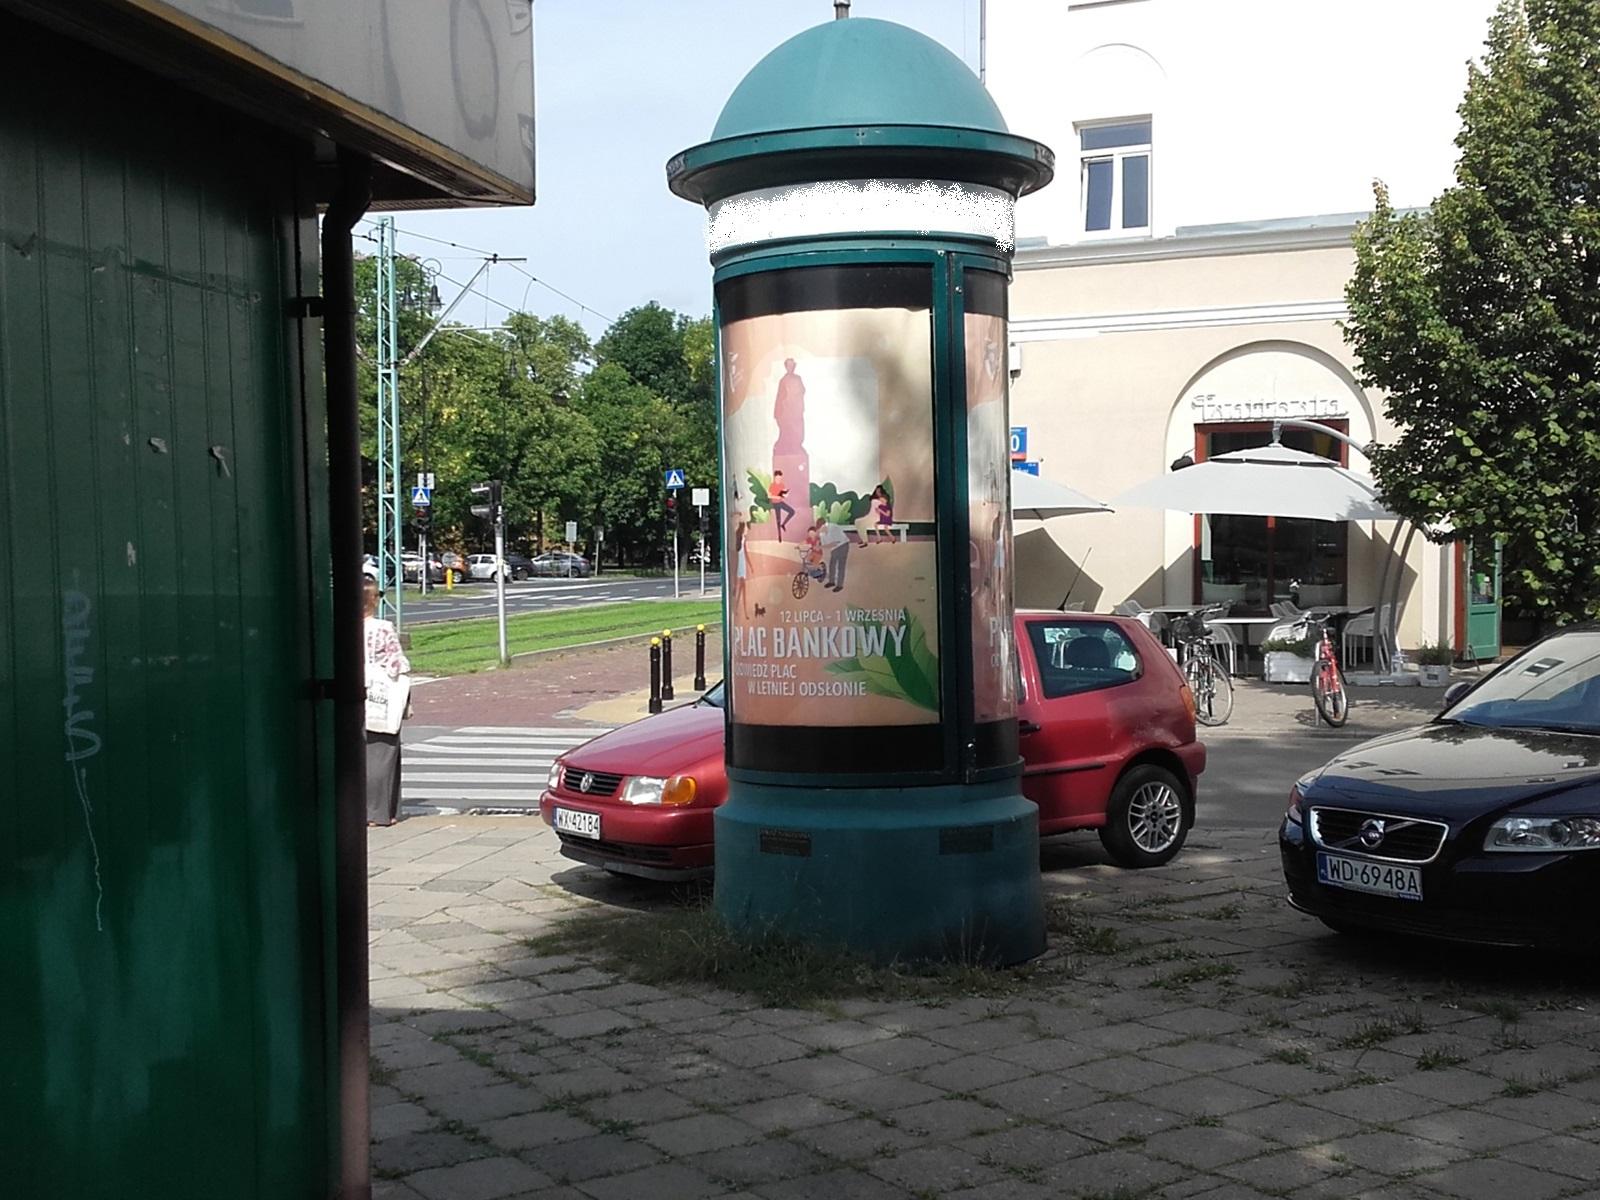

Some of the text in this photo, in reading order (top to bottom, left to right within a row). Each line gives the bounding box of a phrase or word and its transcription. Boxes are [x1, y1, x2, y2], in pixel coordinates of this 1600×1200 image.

[780, 610, 792, 623] 12
[794, 609, 824, 623] LIPCA
[836, 610, 841, 622] 1
[734, 624, 907, 658] PLAC BANKOWY
[771, 664, 797, 679] PLAC
[758, 681, 795, 697] LETNIEJ
[799, 681, 867, 697] ODSŁONIE
